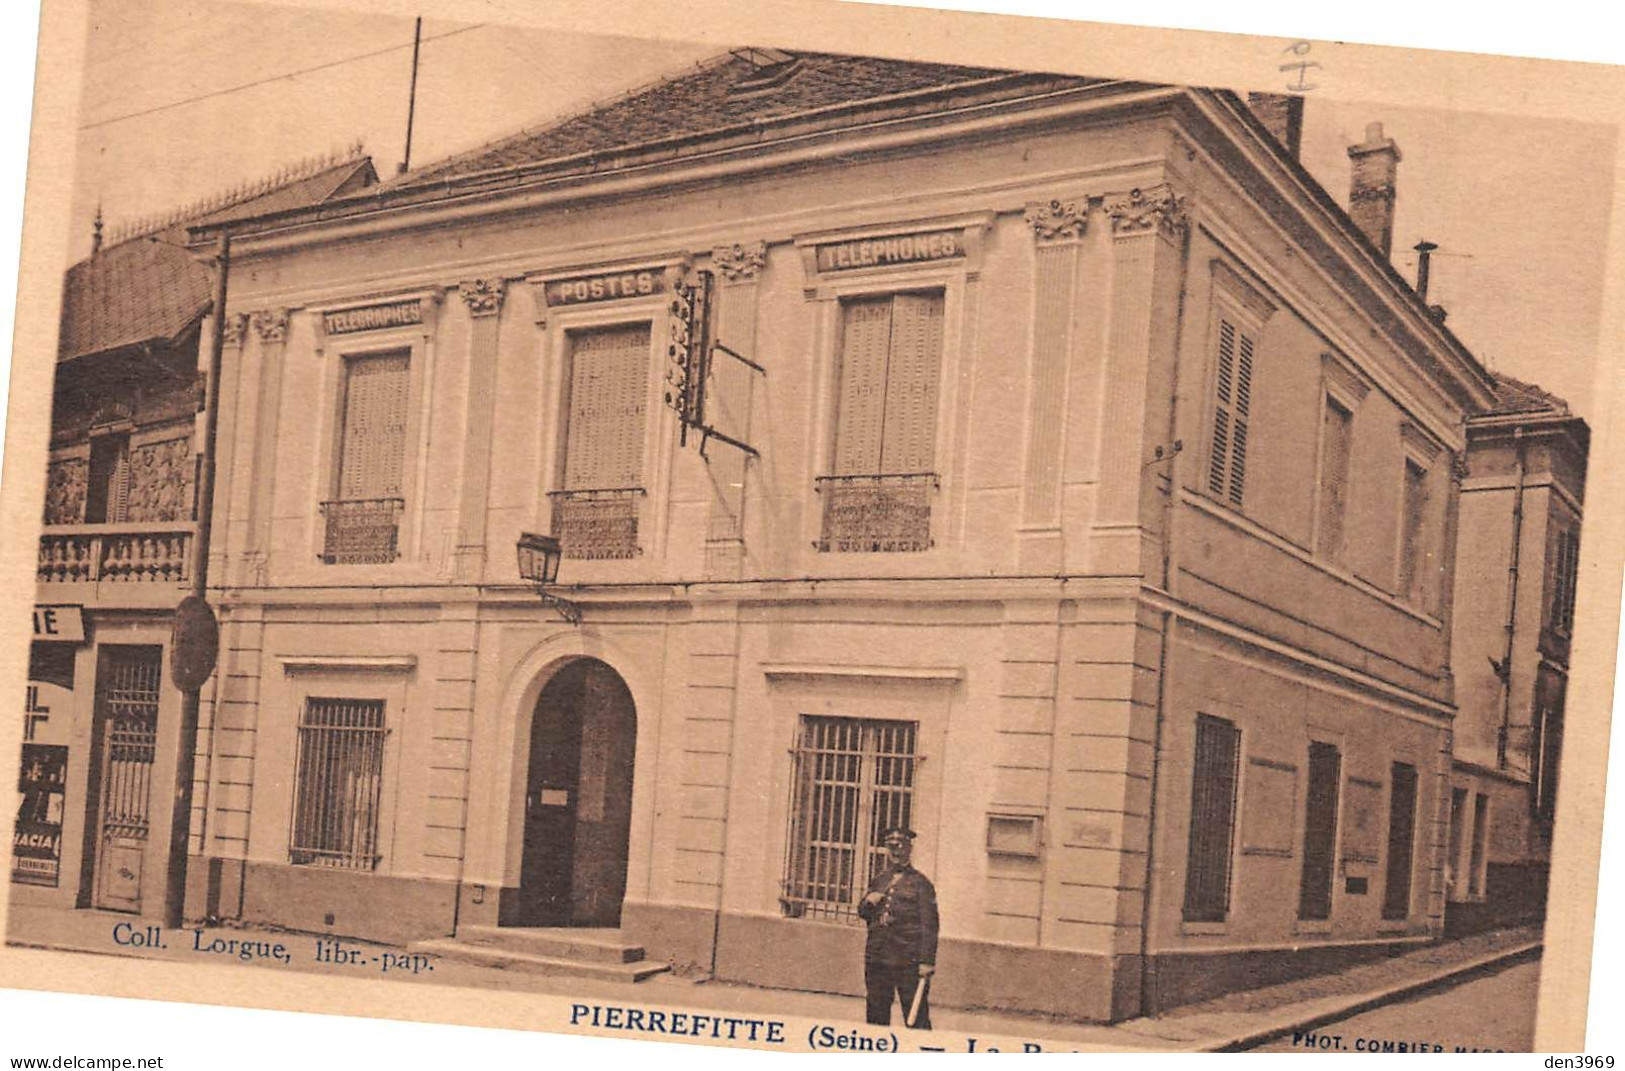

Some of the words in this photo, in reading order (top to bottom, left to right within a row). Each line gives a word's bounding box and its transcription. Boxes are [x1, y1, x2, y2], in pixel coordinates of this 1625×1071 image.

[560, 272, 653, 303] POSTES
[112, 922, 168, 949] Coll.
[193, 929, 292, 964] Lorgue,
[570, 1003, 786, 1044] PIERREFITTE
[808, 1025, 899, 1054] (Seine)
[1292, 1031, 1348, 1051] PHOT.
